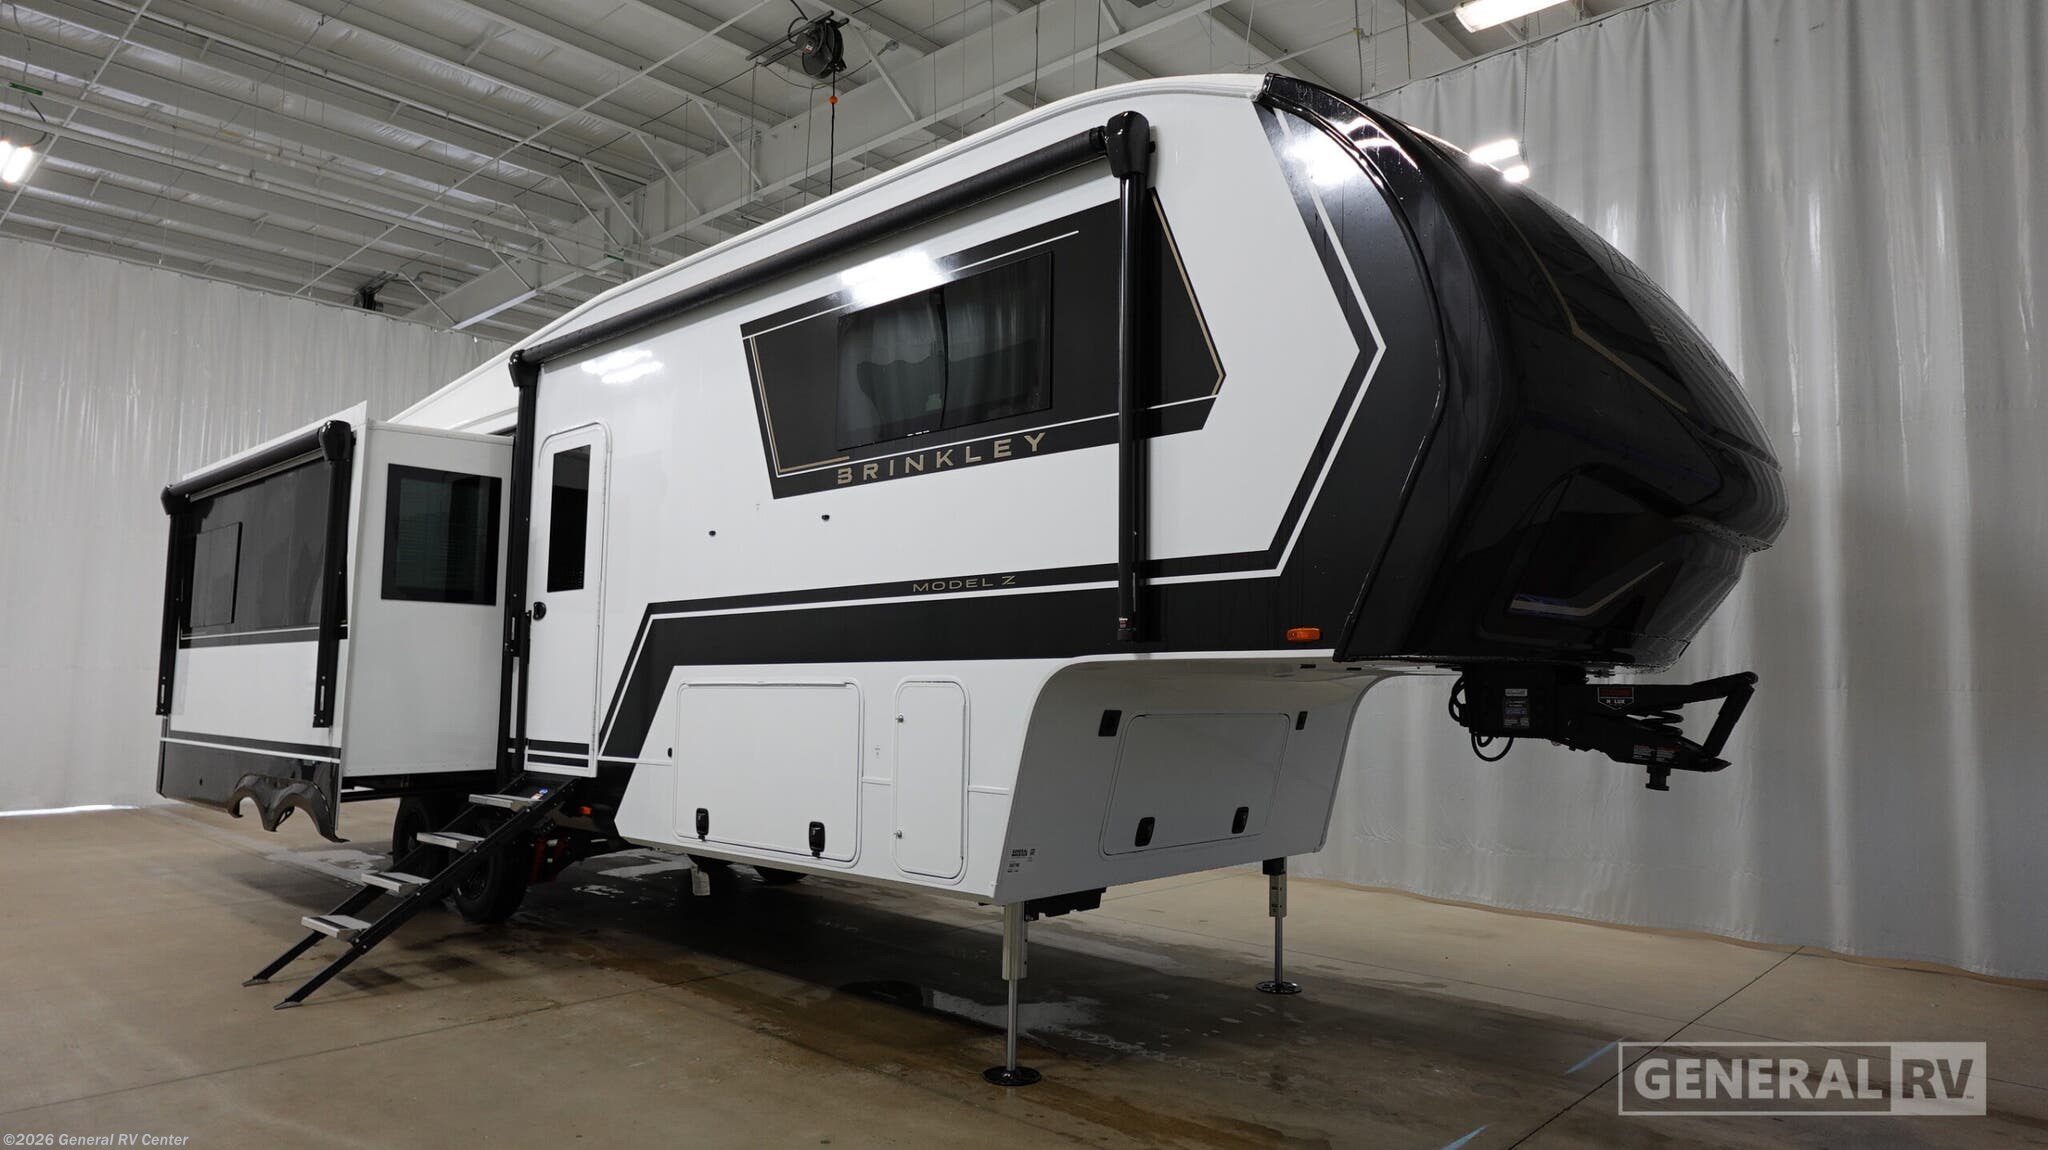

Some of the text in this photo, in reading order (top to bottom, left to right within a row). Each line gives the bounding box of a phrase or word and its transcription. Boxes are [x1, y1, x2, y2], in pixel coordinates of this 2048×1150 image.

[837, 432, 1046, 485] BRINKLEY
[912, 575, 1016, 593] MODEL Z
